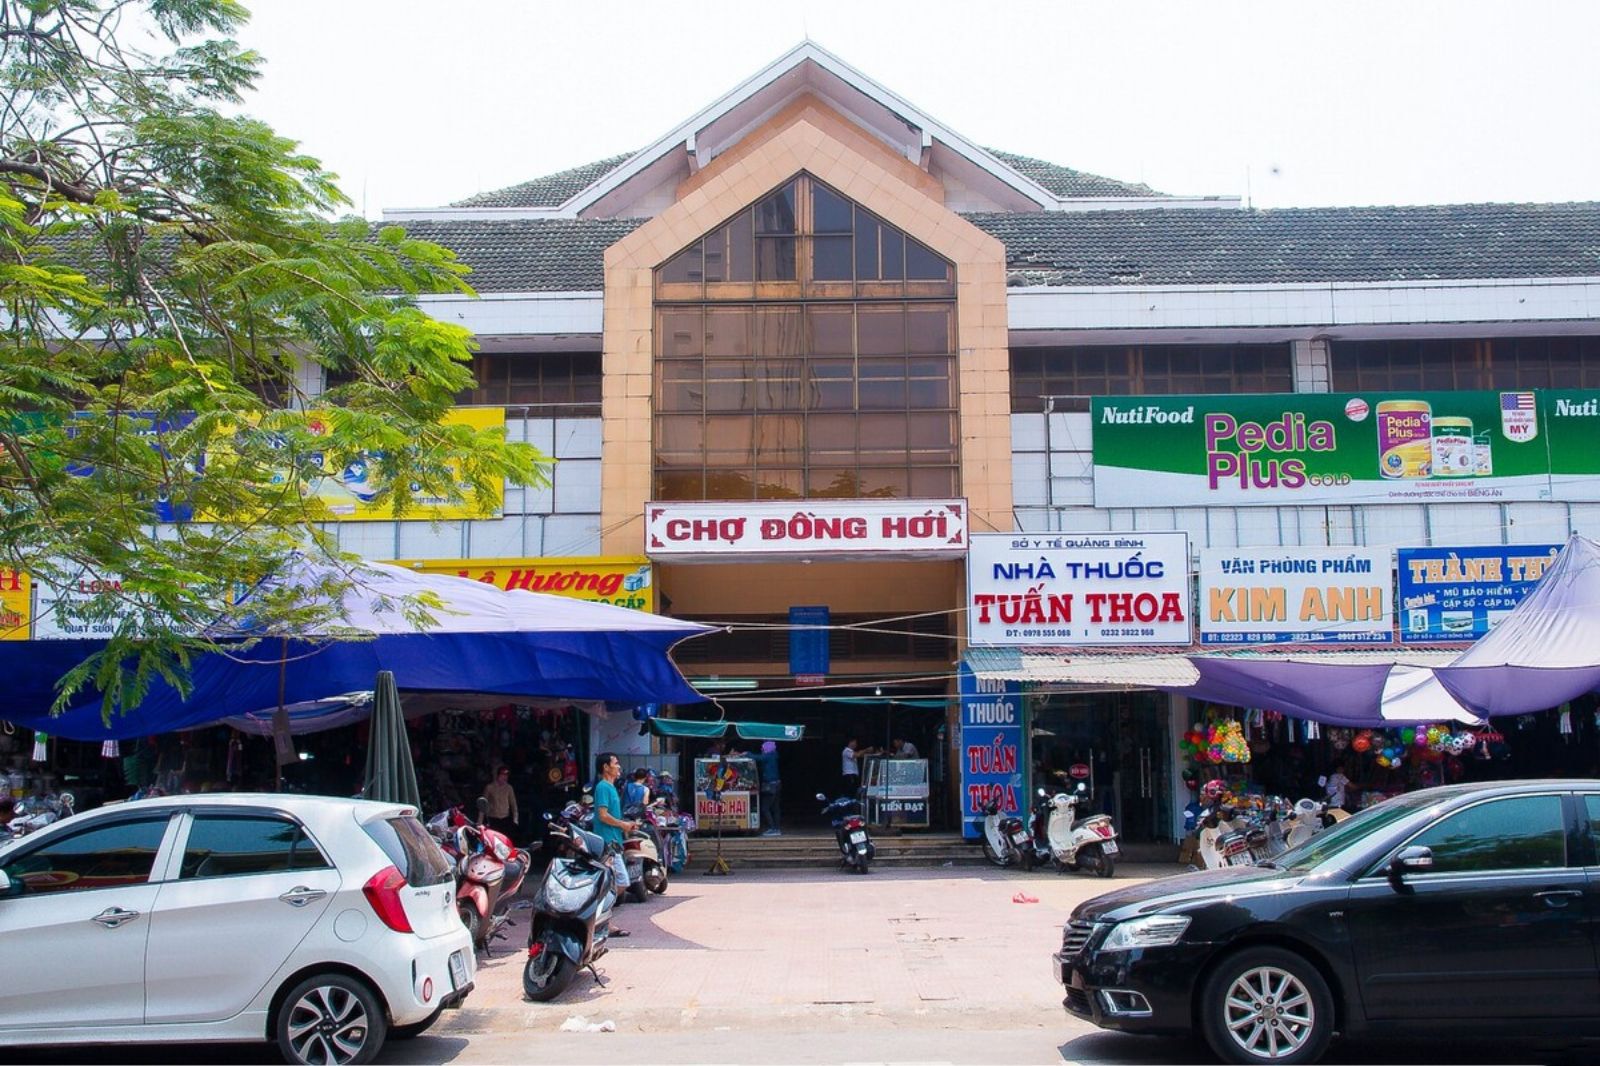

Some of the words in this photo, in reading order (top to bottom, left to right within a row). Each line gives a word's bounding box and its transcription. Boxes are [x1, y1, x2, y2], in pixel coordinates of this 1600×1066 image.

[1101, 406, 1194, 424] NutiFood
[1387, 416, 1420, 427] Pedia
[1555, 399, 1600, 416] Nuti
[1205, 413, 1336, 452] Pedia
[1388, 428, 1413, 438] Plus
[1207, 452, 1306, 490] Plus
[1309, 475, 1350, 486] GOLD
[666, 517, 747, 545] CHỢ
[760, 511, 867, 540] ĐỒNG
[881, 509, 947, 539] HỚI
[1046, 536, 1062, 548] TẾ
[1065, 537, 1110, 547] QUẢNG
[1115, 537, 1144, 547] BÌNH
[993, 556, 1056, 580] NHÀ
[1066, 551, 1164, 579] THUỐC
[1221, 557, 1254, 574] VĂN
[1260, 556, 1316, 573] PHÒNG
[1322, 554, 1371, 573] PHẨM
[1408, 552, 1503, 584] THÀNH
[505, 569, 625, 596] Hương
[1444, 587, 1459, 597] MŨ
[1463, 586, 1484, 596] BẢO
[1487, 584, 1512, 596] HIỂM
[975, 583, 1073, 624] TUẤN
[1085, 593, 1184, 623] THOA
[1209, 587, 1286, 622] KIM
[1300, 587, 1383, 622] ANH
[968, 695, 1014, 724] THUỐC
[967, 732, 1017, 774] TUẤN
[968, 783, 1018, 813] THOA
